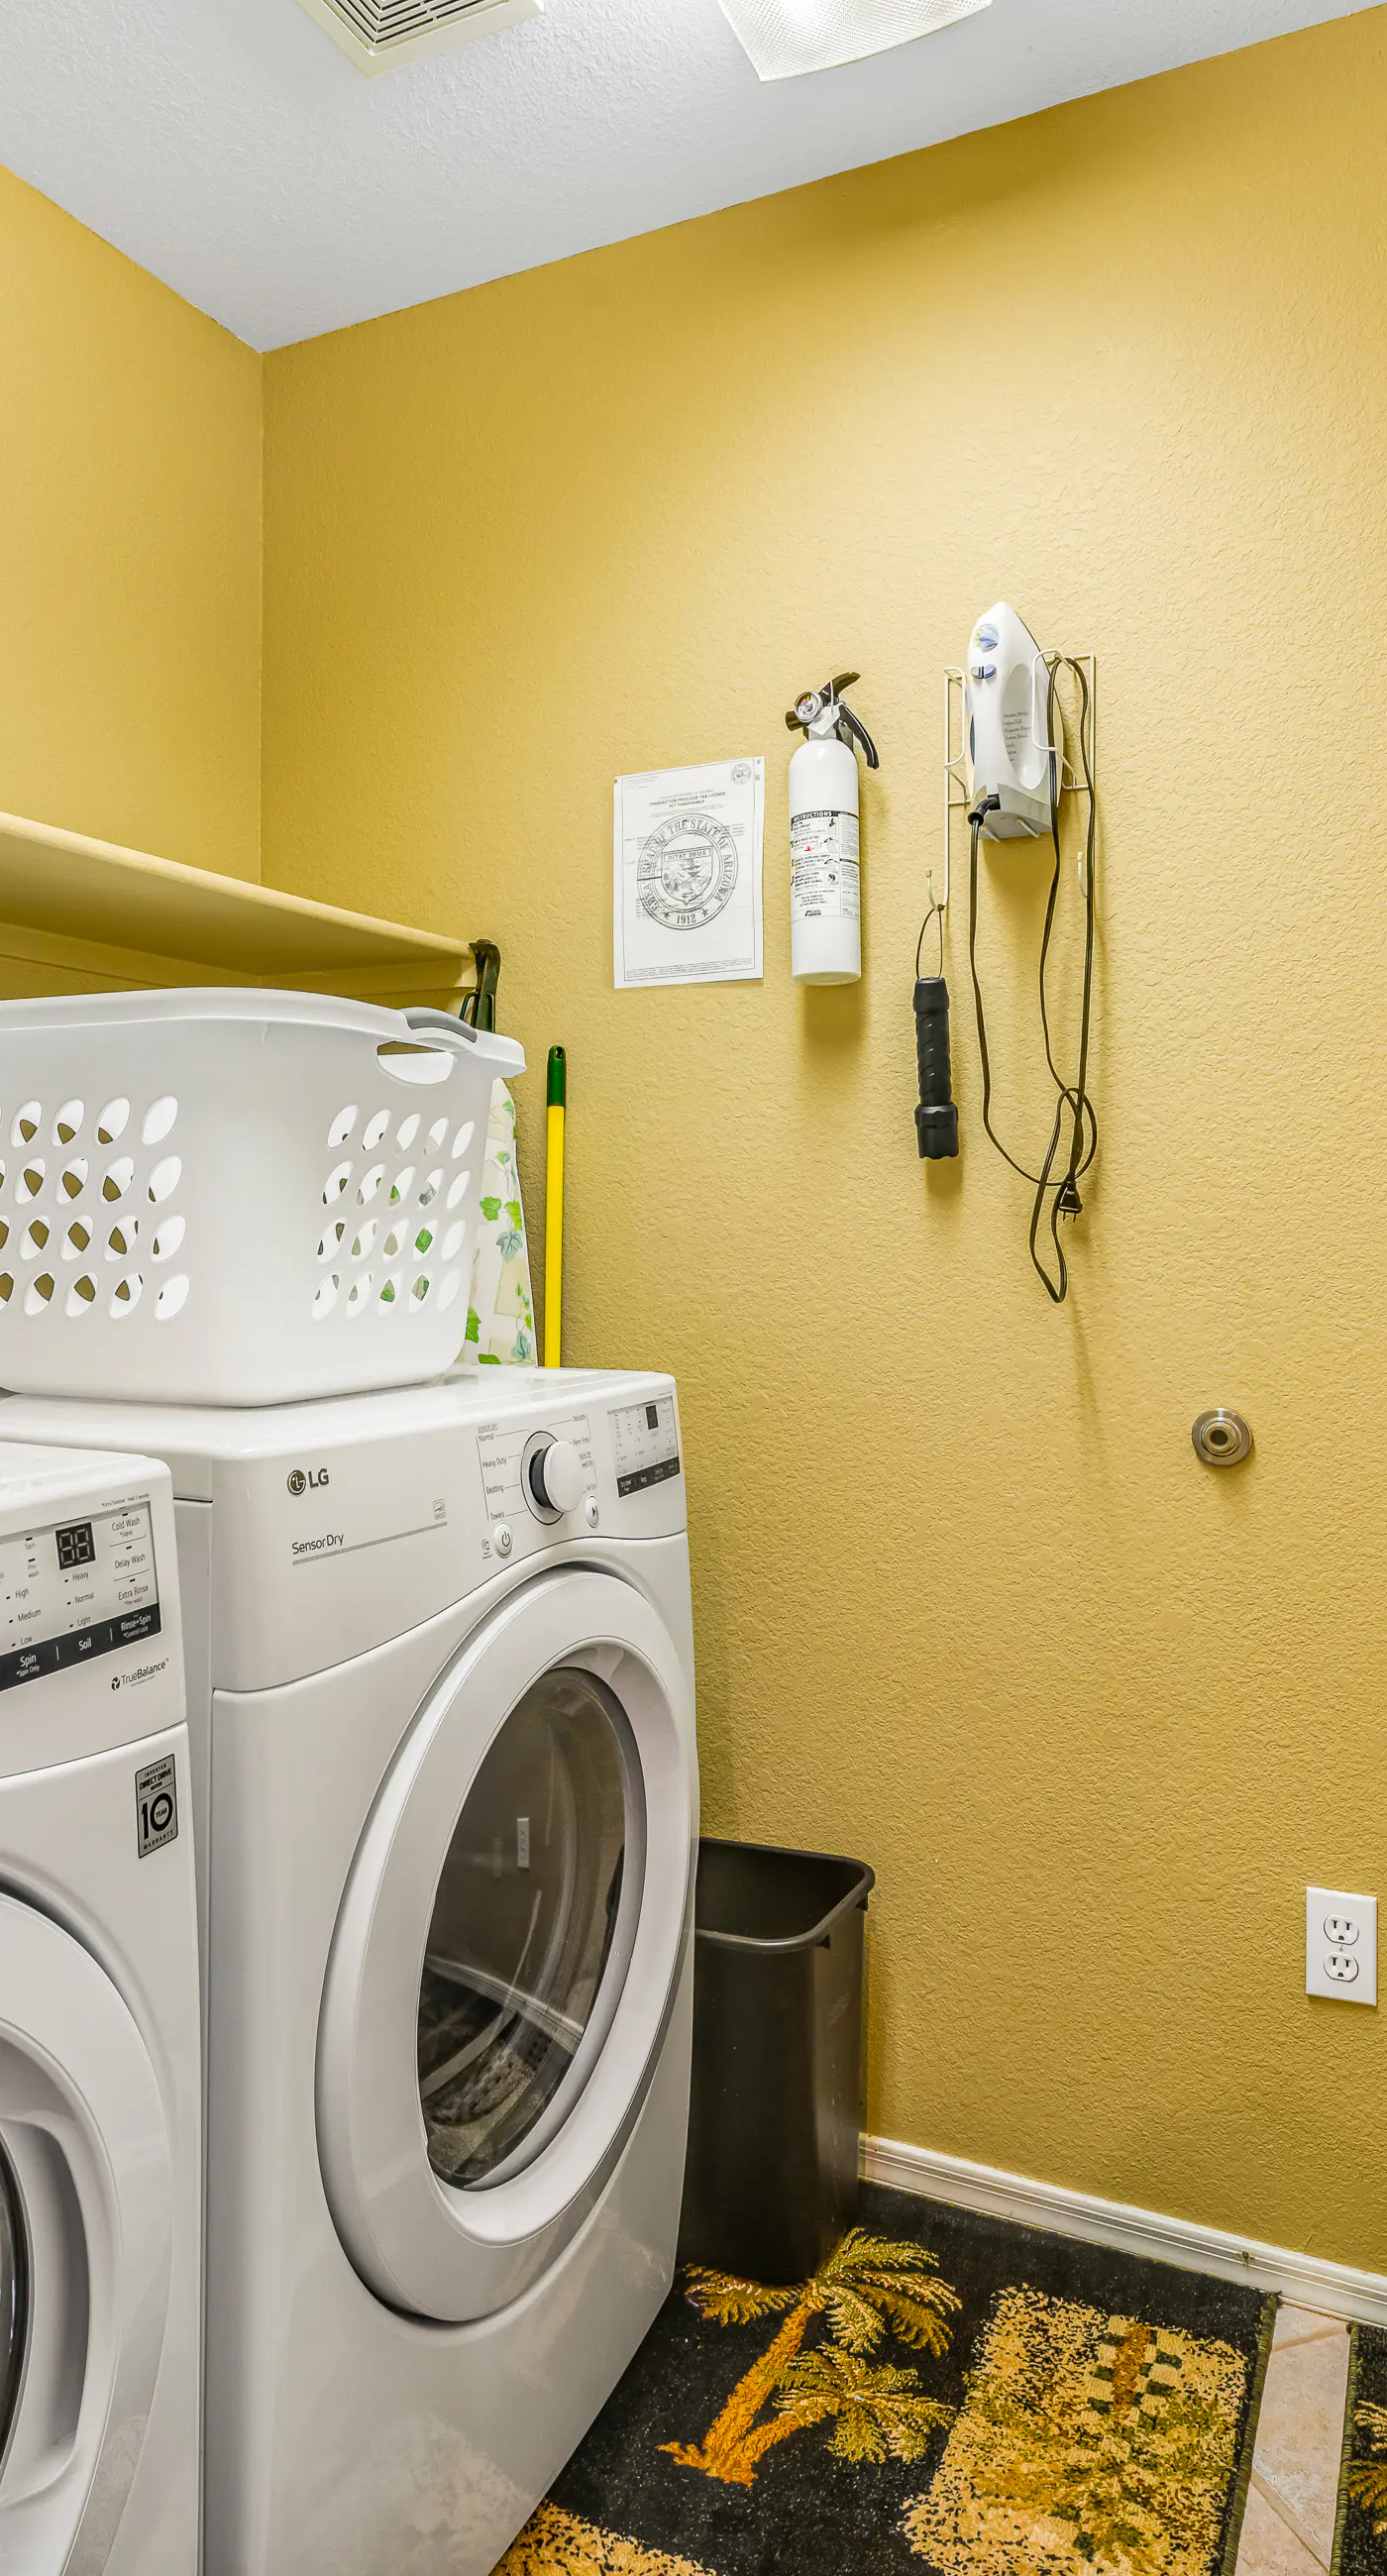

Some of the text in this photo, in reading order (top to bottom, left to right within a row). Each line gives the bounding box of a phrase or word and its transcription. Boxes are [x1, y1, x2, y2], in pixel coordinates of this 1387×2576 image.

[793, 811, 832, 823] INSTRUCTIONS
[668, 819, 688, 834] THE
[714, 854, 733, 902] ARIZONA
[677, 913, 696, 924] 1912
[479, 1433, 494, 1442] Normal
[308, 1468, 330, 1488] LG
[486, 1485, 503, 1494] Bedding
[490, 1511, 505, 1521] Towels
[112, 1517, 141, 1531] Cold Wash
[115, 1554, 146, 1568] Delay Wash
[72, 1571, 90, 1582] Heavy
[15, 1588, 30, 1599] High
[74, 1591, 95, 1604] Normal
[118, 1585, 149, 1601] Extra Rinse
[18, 1609, 42, 1622] Medium
[77, 1616, 91, 1627] Light
[21, 1637, 33, 1646] Low
[78, 1637, 92, 1652] Soil
[20, 1654, 37, 1667] Spin
[144, 1764, 166, 1777] INVERTER
[140, 1768, 172, 1790] DIRECT DRIVE
[141, 1792, 173, 1840] 10
[156, 1807, 167, 1818] YEAR
[144, 1829, 173, 1850] WARRANTY
